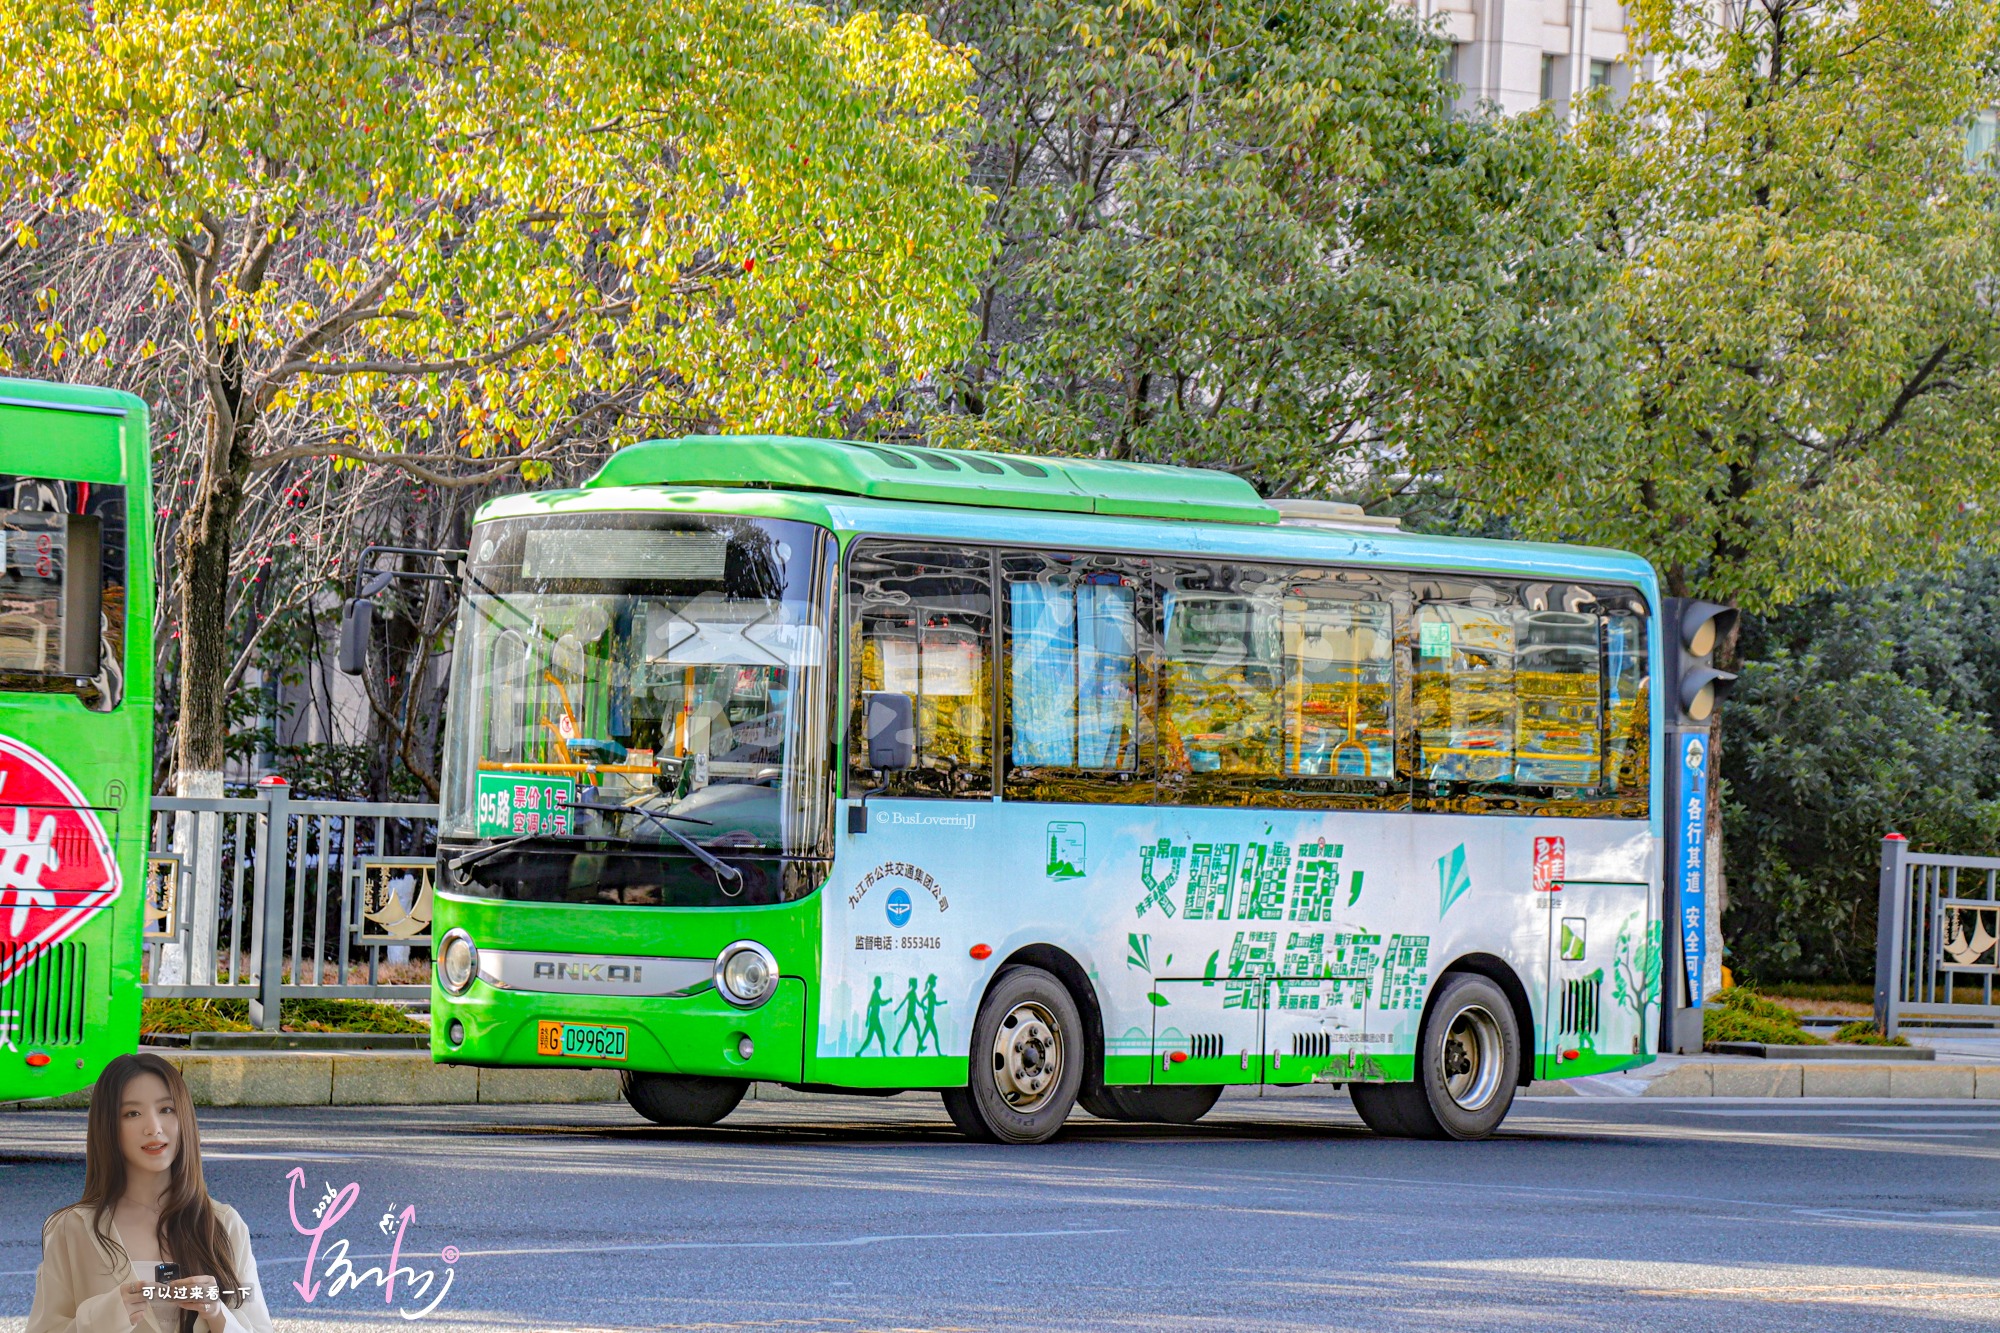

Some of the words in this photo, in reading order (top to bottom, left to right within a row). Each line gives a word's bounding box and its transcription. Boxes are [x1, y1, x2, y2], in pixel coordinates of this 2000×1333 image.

[480, 789, 510, 829] 95路
[1686, 797, 1702, 893] 各行其道
[848, 861, 949, 913] 九江市公共交通集团公司
[534, 961, 642, 983] ANKAI
